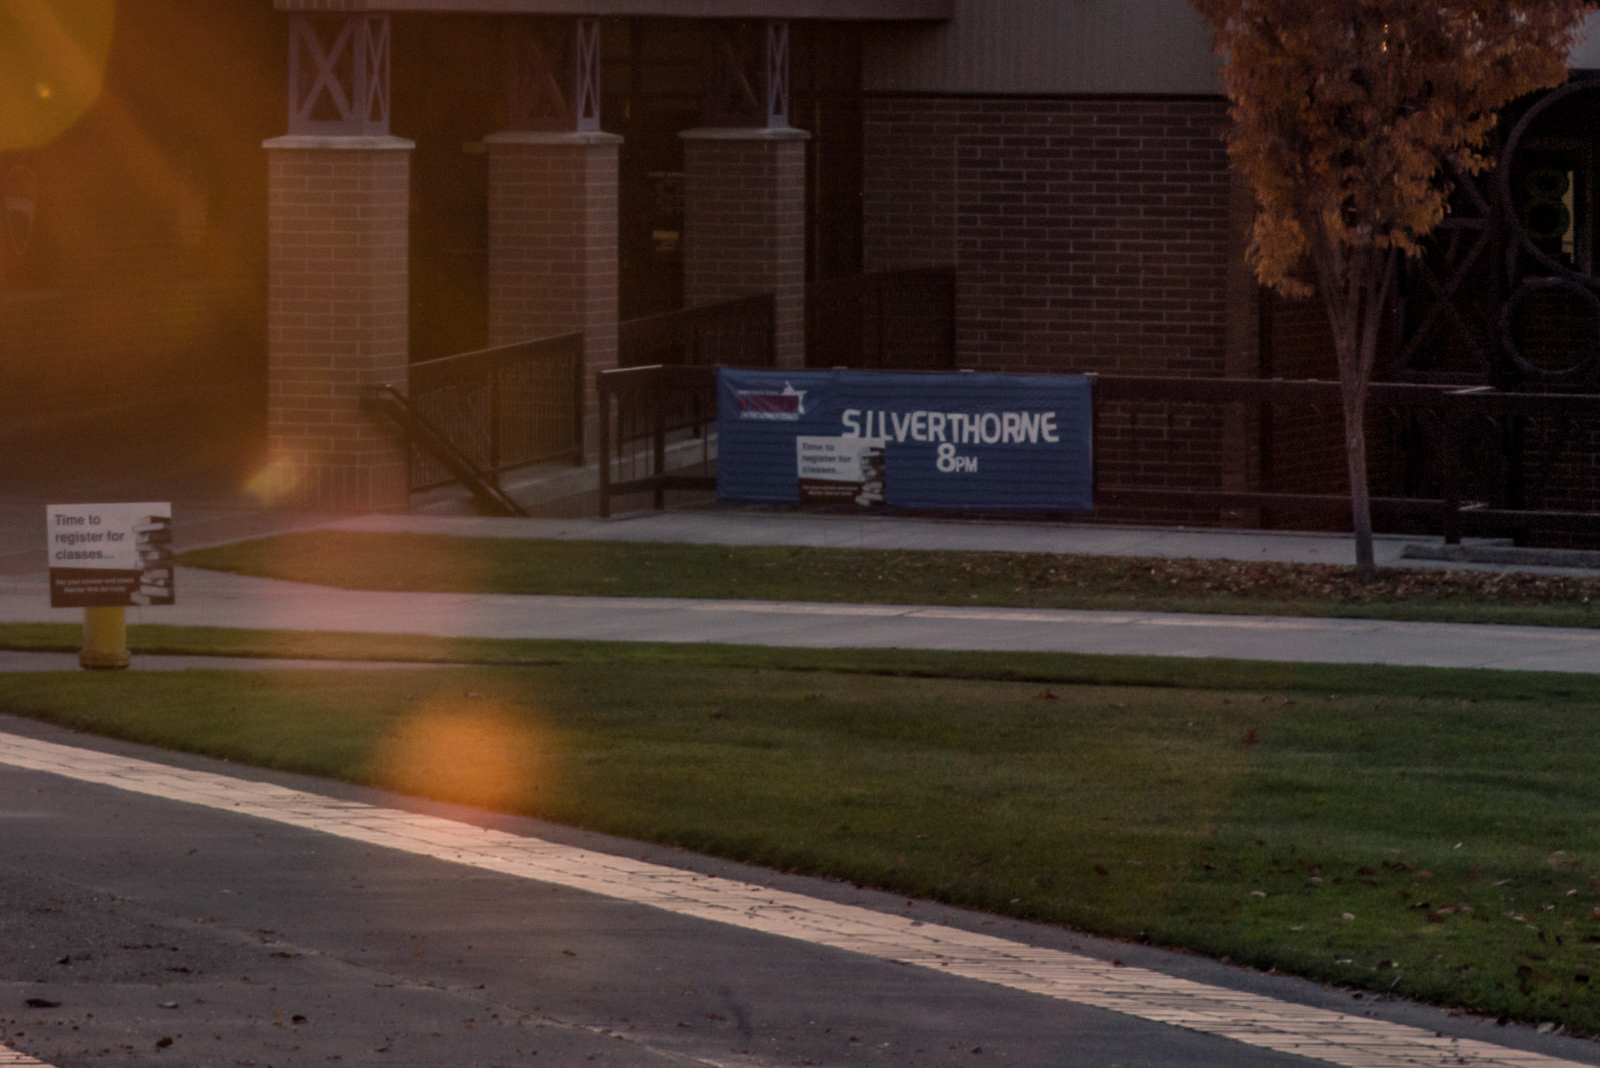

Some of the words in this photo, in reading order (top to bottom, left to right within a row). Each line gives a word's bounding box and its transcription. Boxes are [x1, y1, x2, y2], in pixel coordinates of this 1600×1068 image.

[841, 409, 1059, 444] SILVERTHORNE
[801, 442, 823, 451] Time
[825, 443, 835, 451] to
[801, 455, 836, 464] register
[838, 455, 852, 463] for
[54, 514, 85, 525] Time
[89, 514, 101, 525] to
[55, 531, 104, 545] register
[107, 530, 125, 542] for
